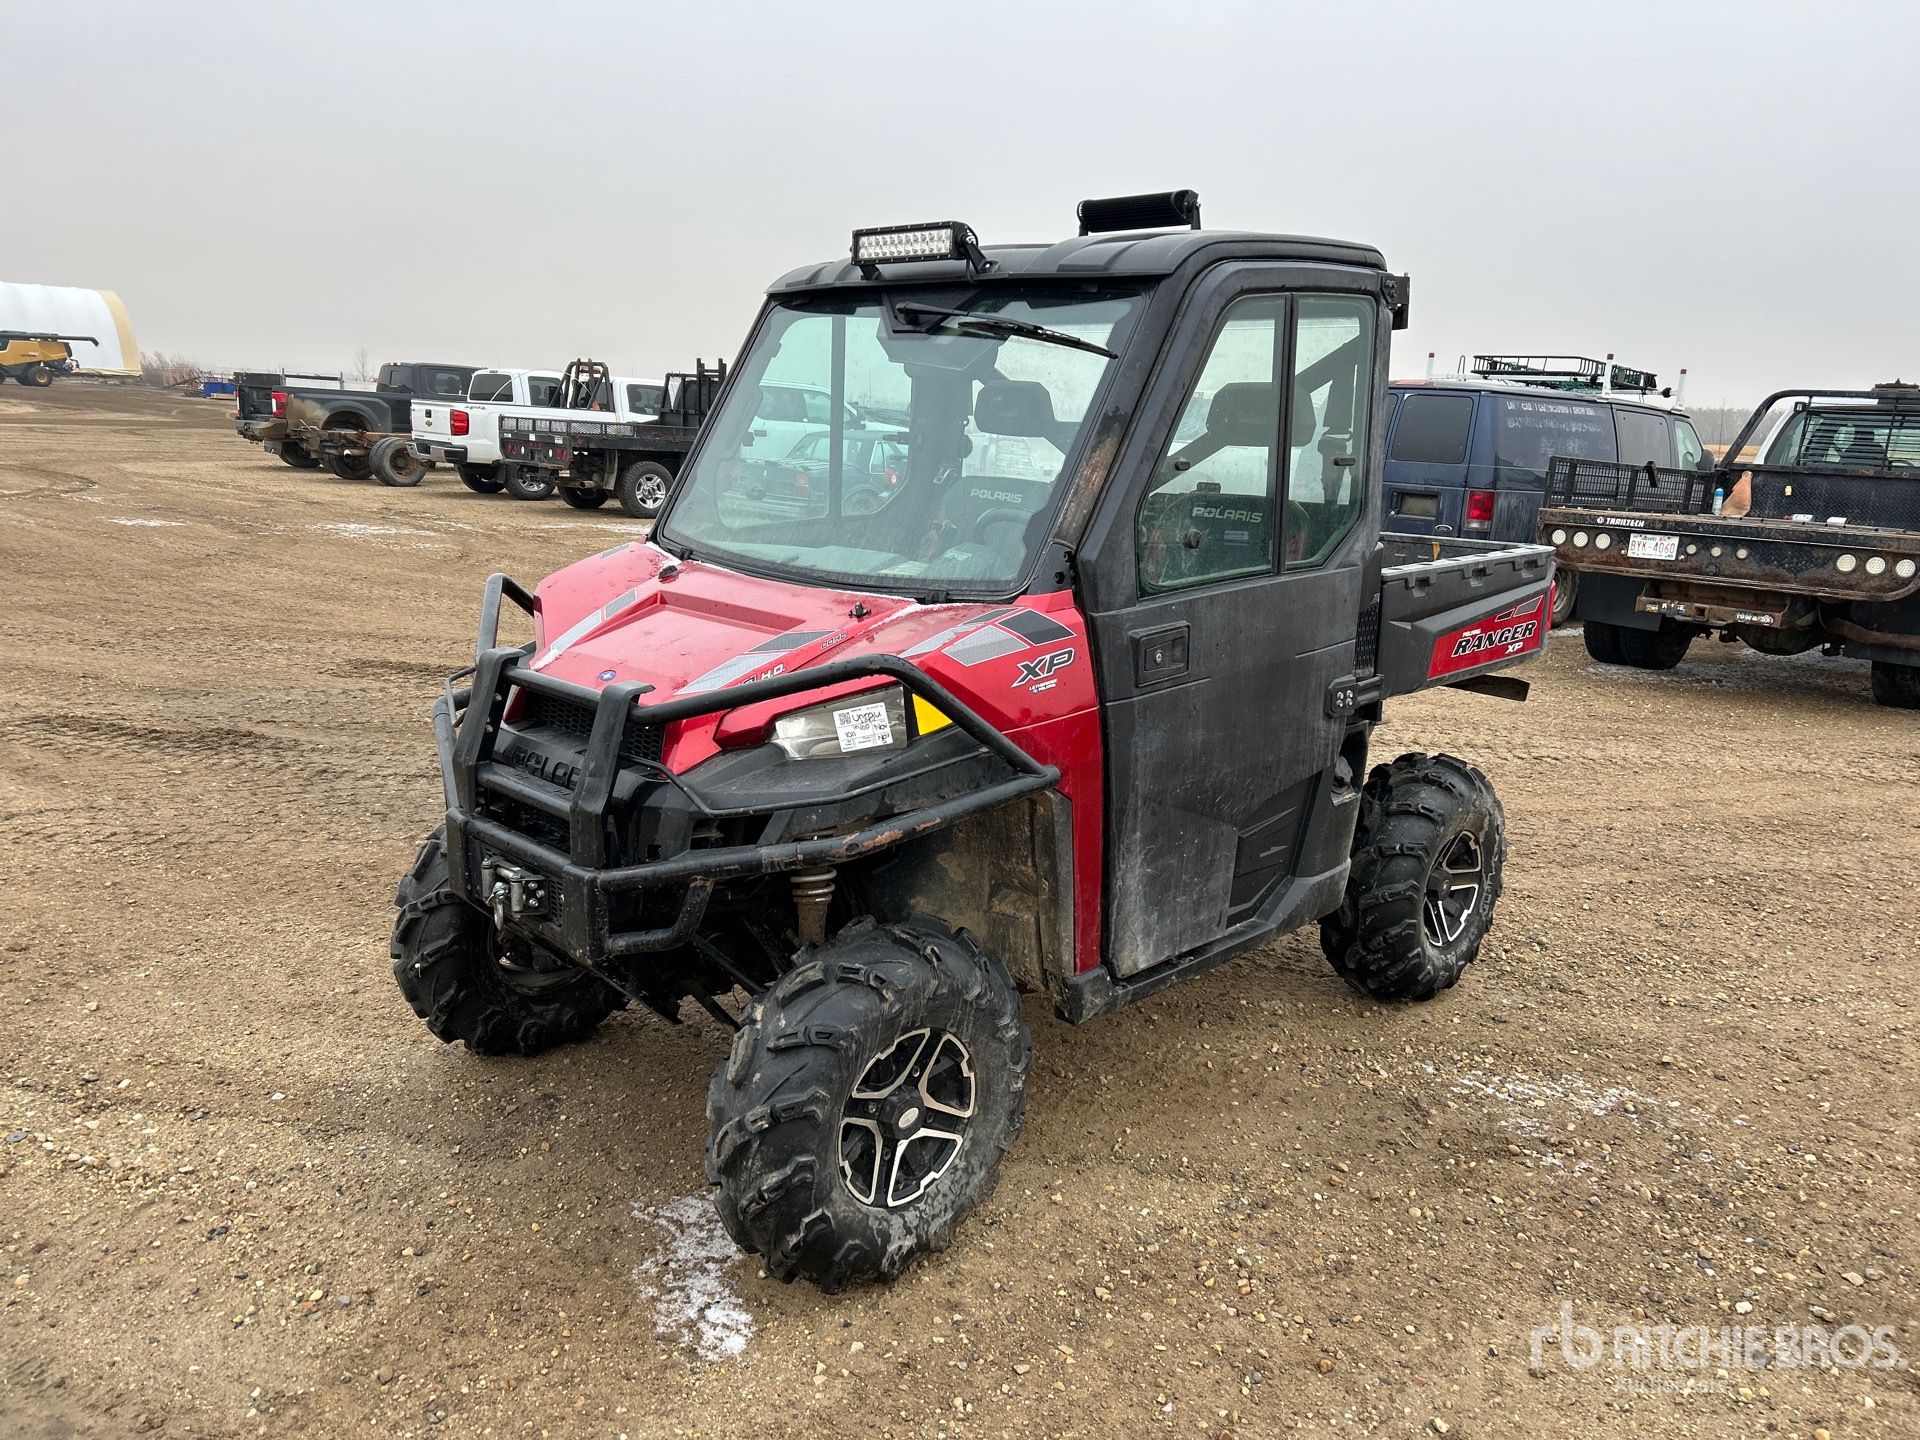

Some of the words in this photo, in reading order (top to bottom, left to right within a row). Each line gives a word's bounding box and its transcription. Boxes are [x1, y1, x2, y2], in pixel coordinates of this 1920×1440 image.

[970, 488, 1023, 503] POLARIS
[1192, 506, 1263, 523] POLARIS
[1606, 517, 1645, 527] TRAILTECH
[1630, 540, 1676, 554] BYK-4060
[1451, 620, 1537, 657] RANGER
[1505, 641, 1524, 654] XP
[1010, 647, 1075, 688] XP
[511, 745, 582, 792] POLAR
